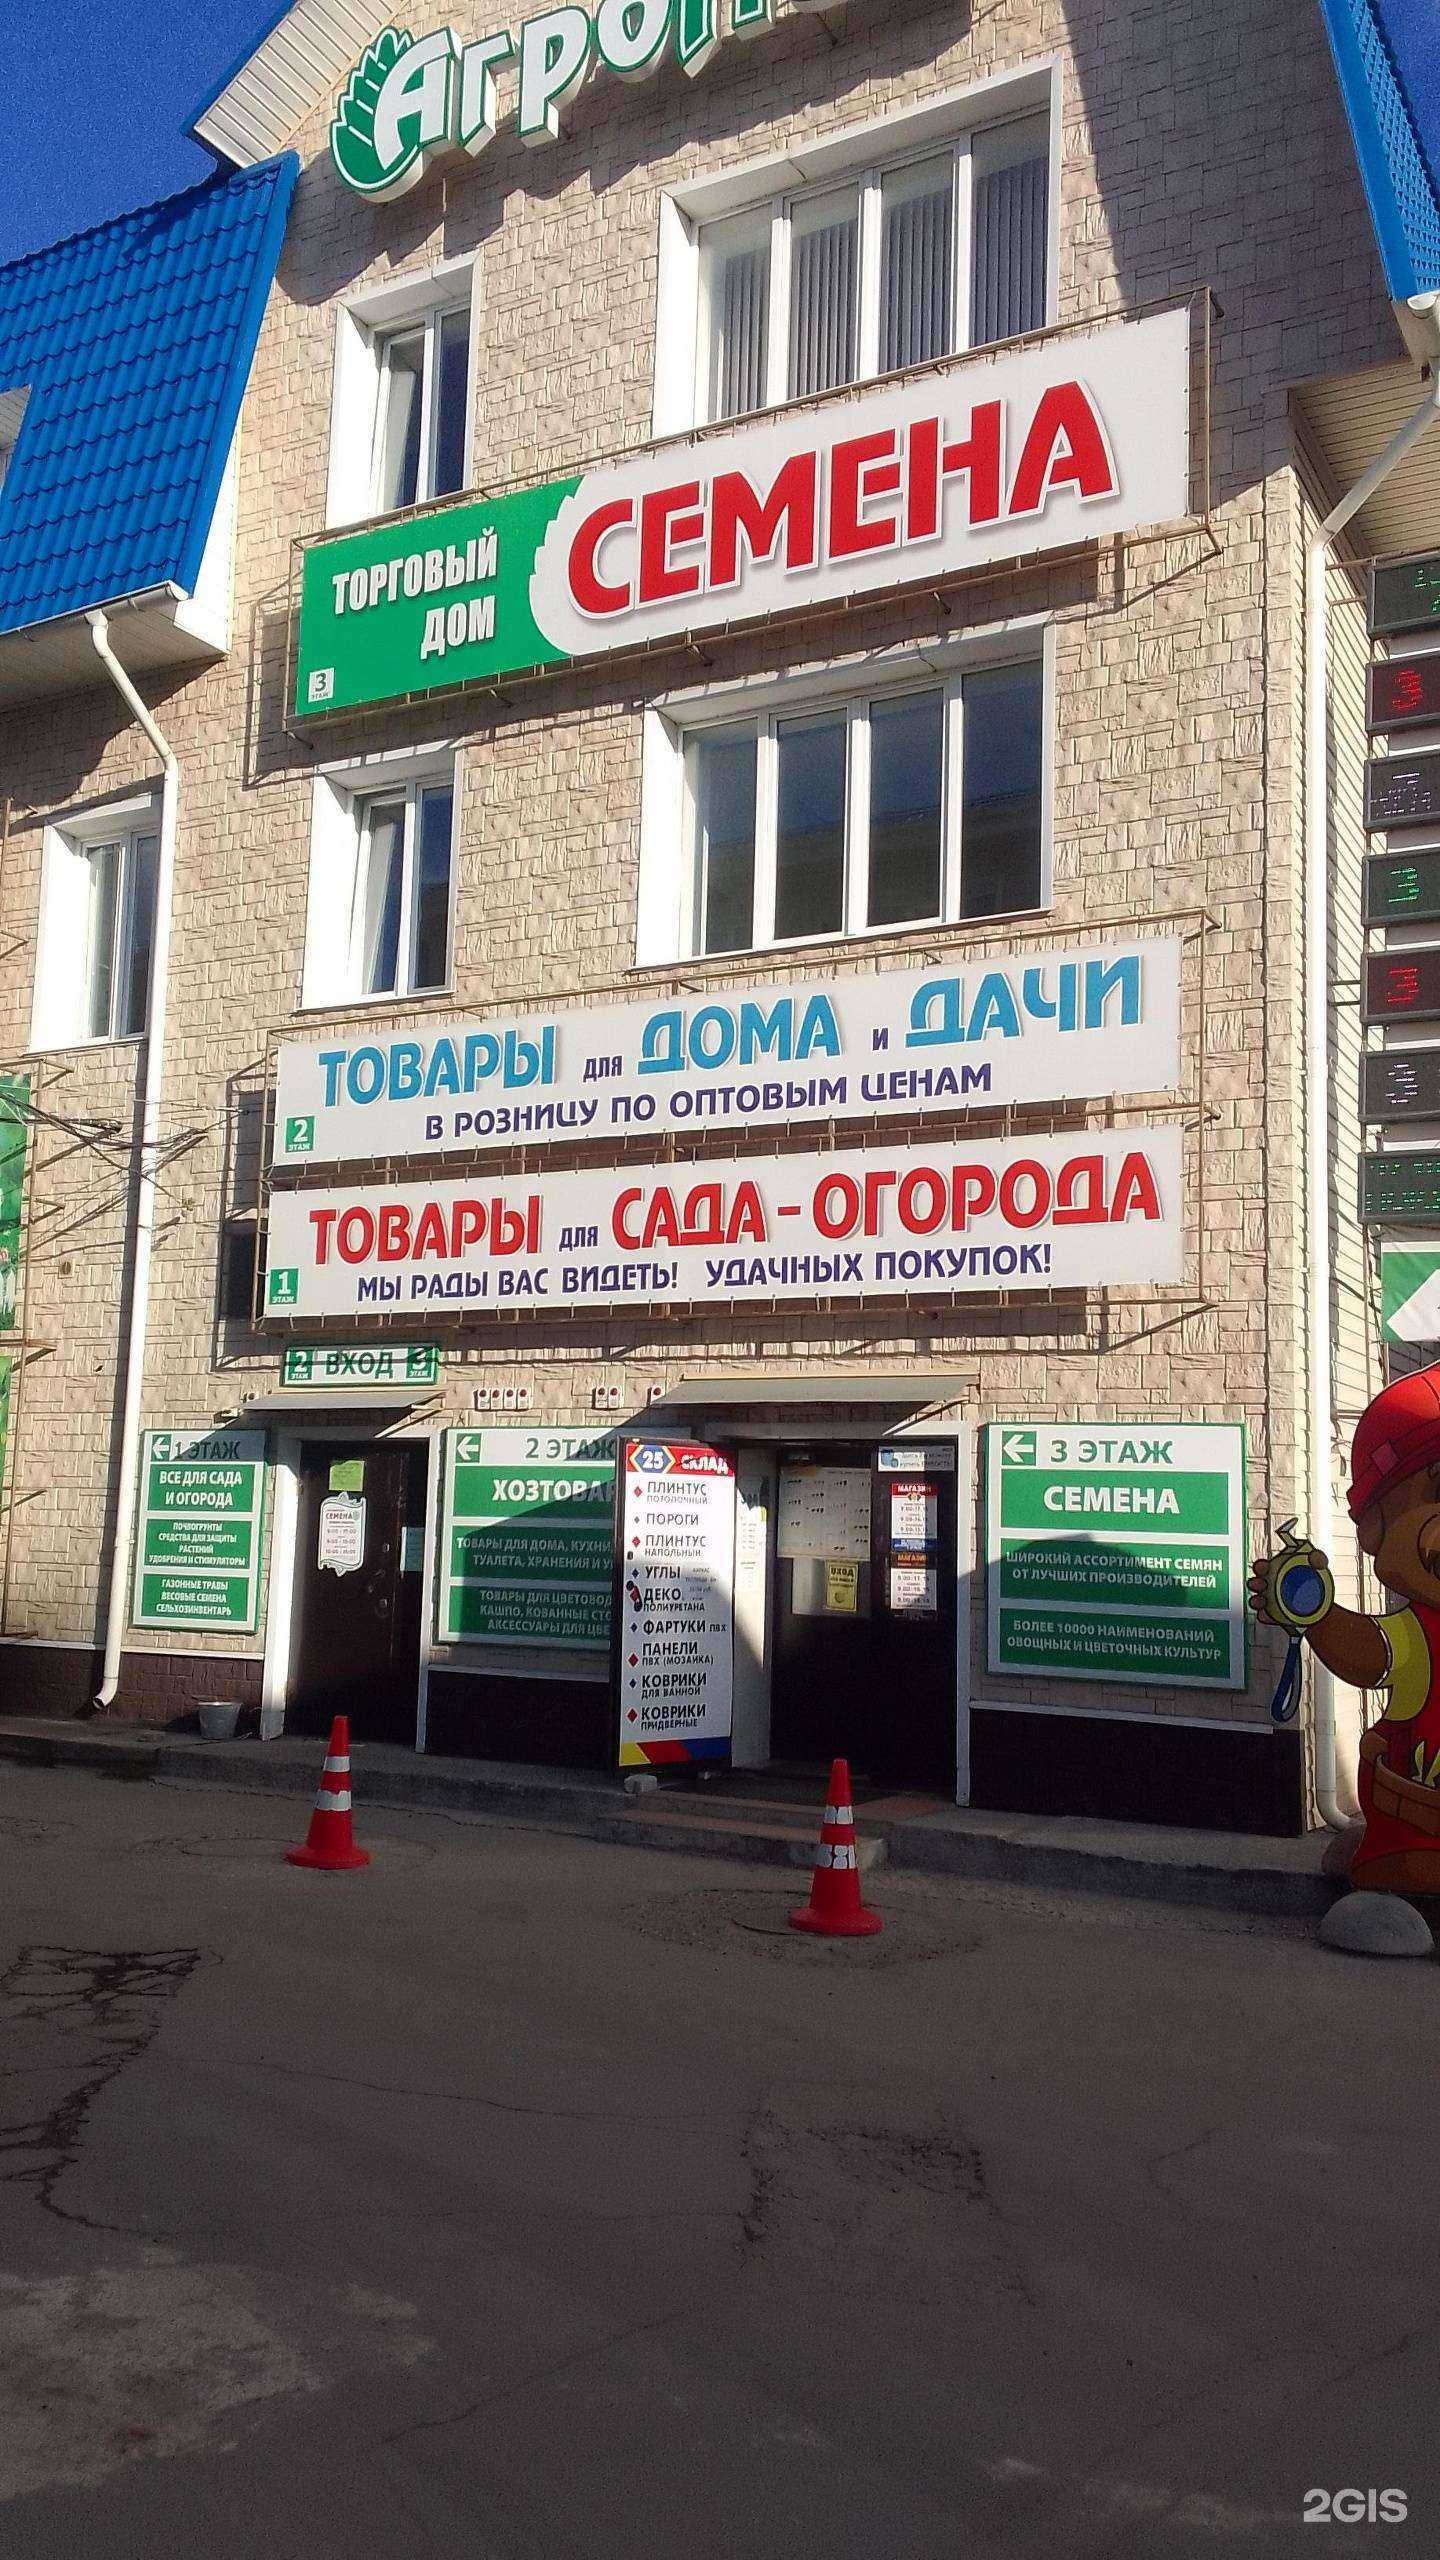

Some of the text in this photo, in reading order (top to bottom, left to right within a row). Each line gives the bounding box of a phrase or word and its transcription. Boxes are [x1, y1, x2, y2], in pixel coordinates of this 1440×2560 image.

[568, 379, 1116, 614] СЕМЕНА
[332, 526, 498, 615] ТОРГОВЫЙ
[420, 595, 496, 660] ДОМ
[315, 672, 327, 691] 3
[318, 1025, 555, 1108] ТОВАРЫ
[637, 994, 842, 1075] ДОМА
[905, 955, 1142, 1048] ДАЧИ
[426, 1063, 993, 1140] В РОЗНИЦУ ПО ОПТОВЫМ ЦЕНАМ
[294, 1119, 308, 1142] 2
[289, 1143, 311, 1151] ЭТАЖ
[309, 1195, 542, 1265] ТОВАРЫ
[358, 1243, 1052, 1301] МЫ РАДЫ ВАС ВИДЕТЬ! УДАЧНЫХ ПОКУПОК!
[278, 1271, 291, 1294] 1
[294, 1348, 427, 1379] 2 ВХОД 3
[175, 1441, 241, 1459] 1 ЭТАЖ
[526, 1437, 615, 1460] 2 ЭТАЖ
[1050, 1440, 1173, 1464] 3 ЭТАЖ
[642, 1450, 664, 1469] 25
[159, 1470, 243, 1488] ВСЕ ДЛЯ САДА
[647, 1481, 707, 1497] ПЛИНТУС
[165, 1492, 234, 1508] И ОГОРОДА
[647, 1496, 708, 1505] ПОТОЛОЧНЫЙ
[1043, 1485, 1180, 1515] СЕМЕНА
[173, 1522, 223, 1532] ПОЧВОГРУНТЫ
[646, 1513, 699, 1526] ПОРОГИ
[158, 1532, 237, 1543] СРЕДСТВА ДЛЯ ЗАЩИТЫ
[457, 1537, 503, 1550] ТОВАРЫ
[505, 1539, 529, 1551] ДЛЯ
[530, 1540, 568, 1551] ДОМА,
[645, 1534, 706, 1548] ПЛИНТУС
[178, 1544, 214, 1554] РАСТЕНИЙ
[149, 1555, 246, 1566] УДОБРЕНИЯ И СТИМУЛЯТОРЫ
[527, 1556, 590, 1568] ХРАНЕНИЯ
[592, 1557, 601, 1568] И
[1006, 1551, 1223, 1571] ШИРОКИЙ АССОРТИМЕНТ СЕМЯН
[645, 1565, 680, 1579] УГЛЫ
[1013, 1568, 1217, 1588] ОТ ЛУЧШИХ ПРОИЗВОДИТЕЛЕЙ
[161, 1579, 229, 1590] ГАЗОННЫЕ ТРАВЫ
[161, 1591, 227, 1603] ВЕСОВЫЕ СЕМЕНА
[480, 1589, 525, 1601] ТОВАРЫ
[527, 1591, 550, 1604] ДЛЯ
[156, 1603, 232, 1616] СЕЛЬХОЗИНВЕНТАРЬ
[526, 1606, 589, 1620] КОВАННЫЕ
[643, 1602, 705, 1612] ПОЛИУРЕТАНА
[488, 1619, 560, 1633] АКСЕССУАРЫ
[562, 1623, 586, 1636] ДЛЯ
[643, 1619, 728, 1635] ФАРТУКИ ПВХ
[1013, 1619, 1215, 1642] БОЛЕЕ 10000 НАИМЕНОВАНИЙ
[642, 1641, 698, 1656] ПАНЕЛИ
[1007, 1636, 1221, 1660] ОВОЩНЫХ И ЦВЕТОЧНЫХ КУЛЬТУР
[642, 1654, 714, 1667] ПВХ (МОЗАИКА)
[642, 1672, 707, 1688] КОВРИКИ
[641, 1686, 701, 1700] ДЛЯ ВАННОЙ
[641, 1703, 706, 1720] КОВРИКИ
[640, 1718, 698, 1731] ПРИДВЕРНЫЕ
